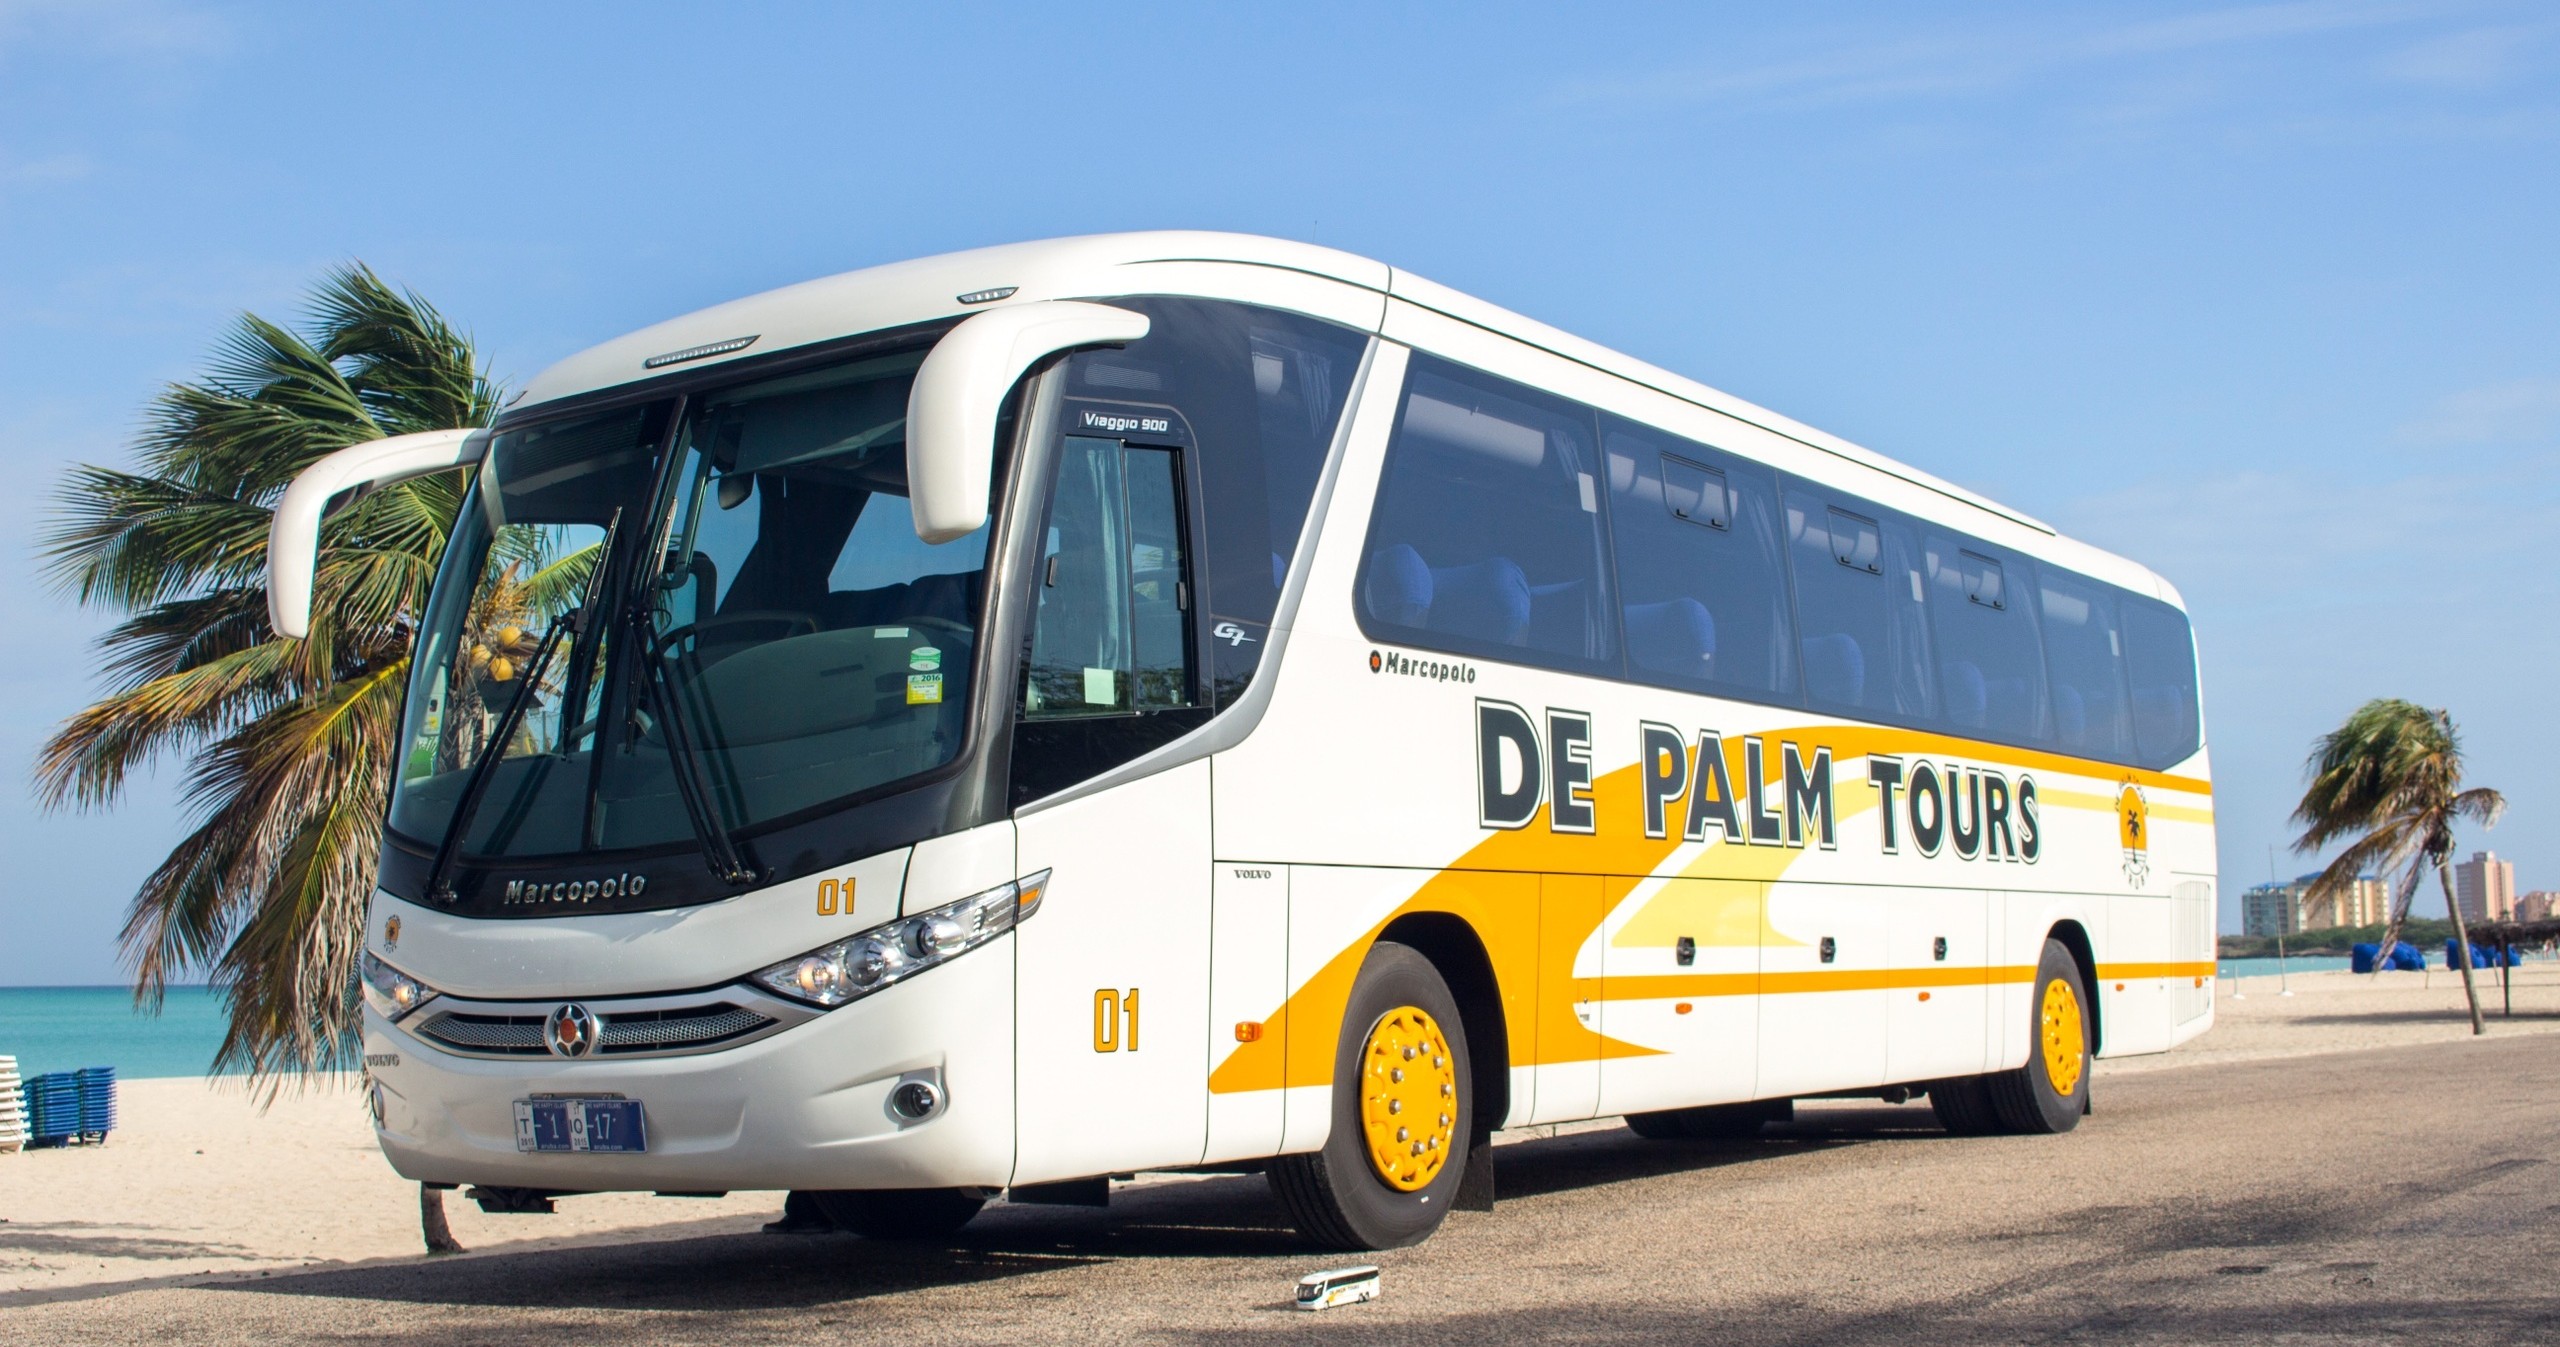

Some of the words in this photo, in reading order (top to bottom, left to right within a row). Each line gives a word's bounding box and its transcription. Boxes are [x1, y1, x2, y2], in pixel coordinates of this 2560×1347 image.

[1085, 413, 1138, 431] Viaggio
[1141, 418, 1168, 432] 900
[1385, 651, 1476, 684] Marcopolo
[1475, 696, 1596, 836] DE
[1639, 719, 1837, 851] PALM
[1867, 752, 2041, 865] TOURS
[504, 872, 647, 904] Marcopolo
[1234, 869, 1272, 879] VOLVO
[816, 877, 856, 916] 01
[1094, 988, 1139, 1053] 01
[366, 1054, 400, 1067] VOLVO
